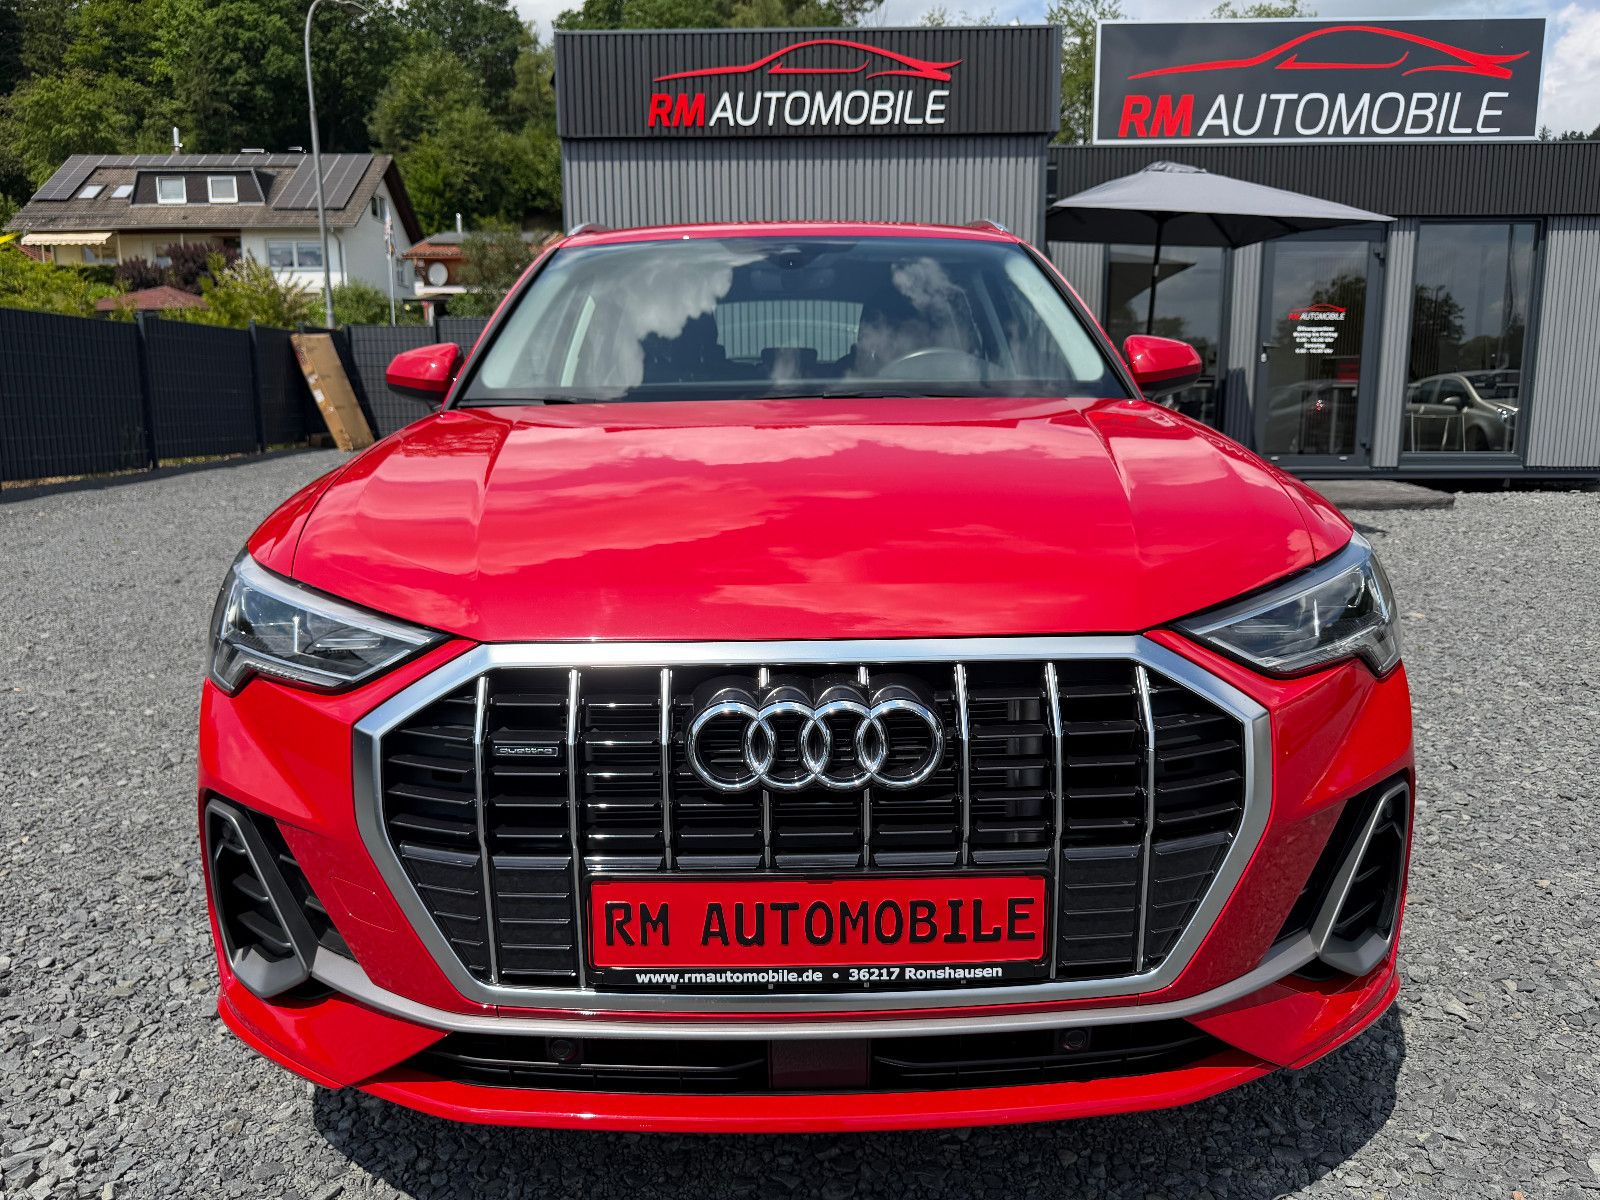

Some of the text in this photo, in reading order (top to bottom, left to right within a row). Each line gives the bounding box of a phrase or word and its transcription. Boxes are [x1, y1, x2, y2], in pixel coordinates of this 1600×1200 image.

[648, 89, 950, 127] RM AUTOMOBILE
[1118, 91, 1509, 137] RM AUTOMOBILE
[605, 897, 1036, 947] RM AUTOMOBILE
[635, 966, 1003, 984] www.rmautomobile.de 36217 Ronshausen
